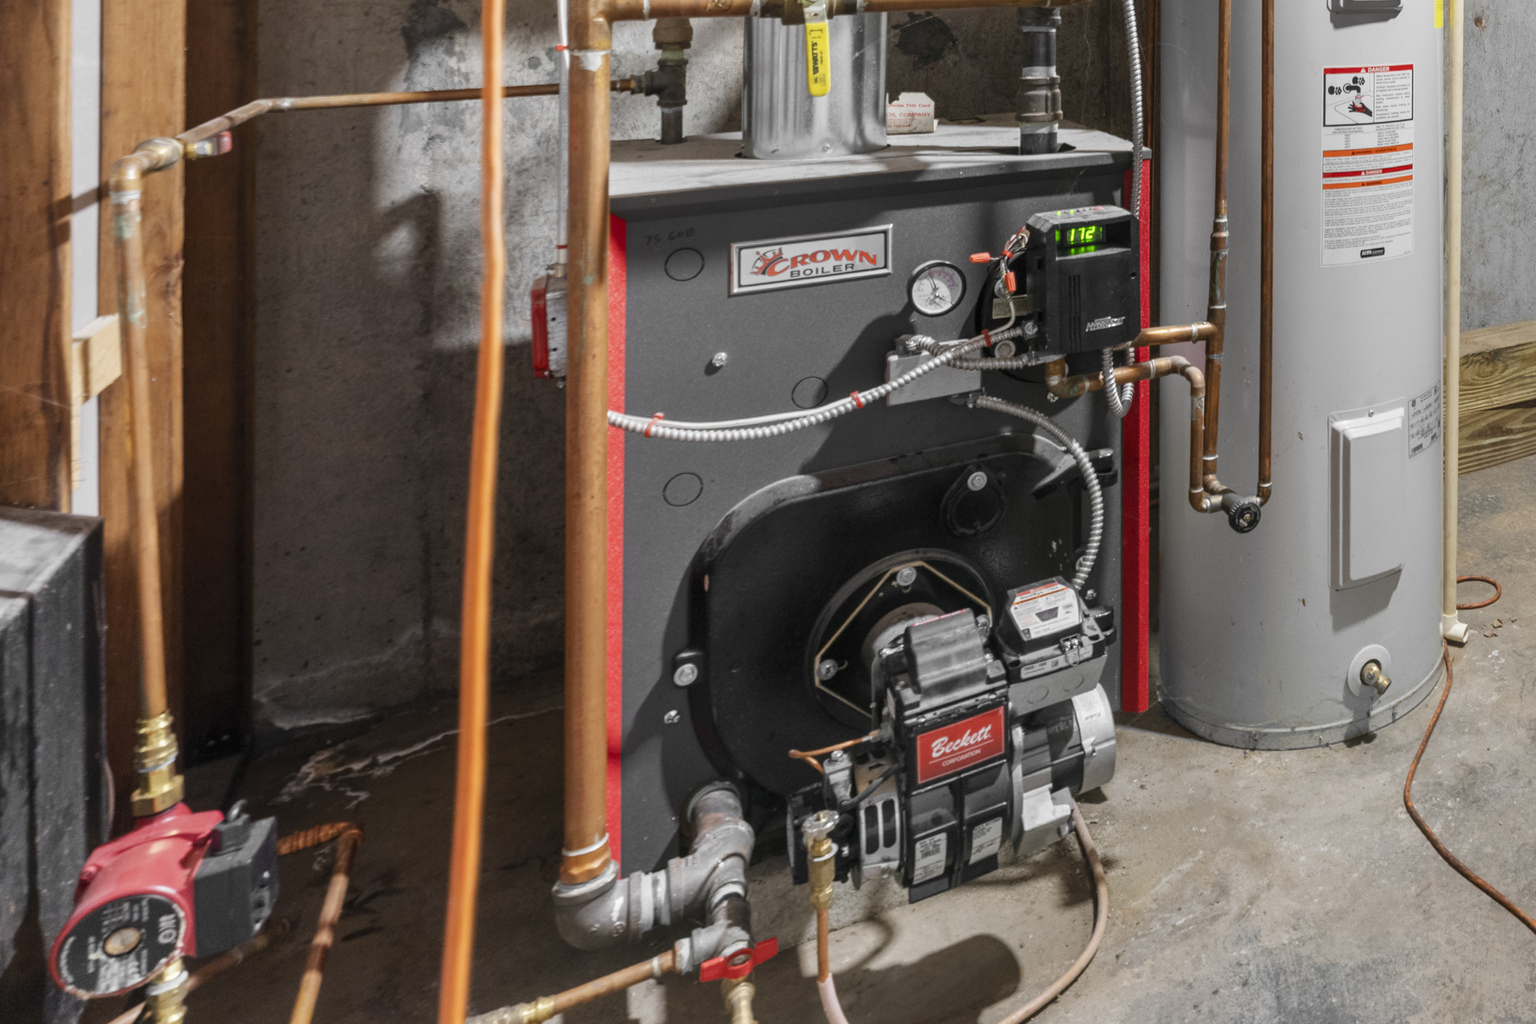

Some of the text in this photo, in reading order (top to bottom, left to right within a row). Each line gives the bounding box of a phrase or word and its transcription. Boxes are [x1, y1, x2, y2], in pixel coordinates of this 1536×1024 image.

[1070, 225, 1096, 243] 172
[766, 247, 877, 277] CROWN
[790, 263, 855, 278] BOILER
[931, 724, 992, 758] Beckett
[942, 748, 982, 767] CORPORATION
